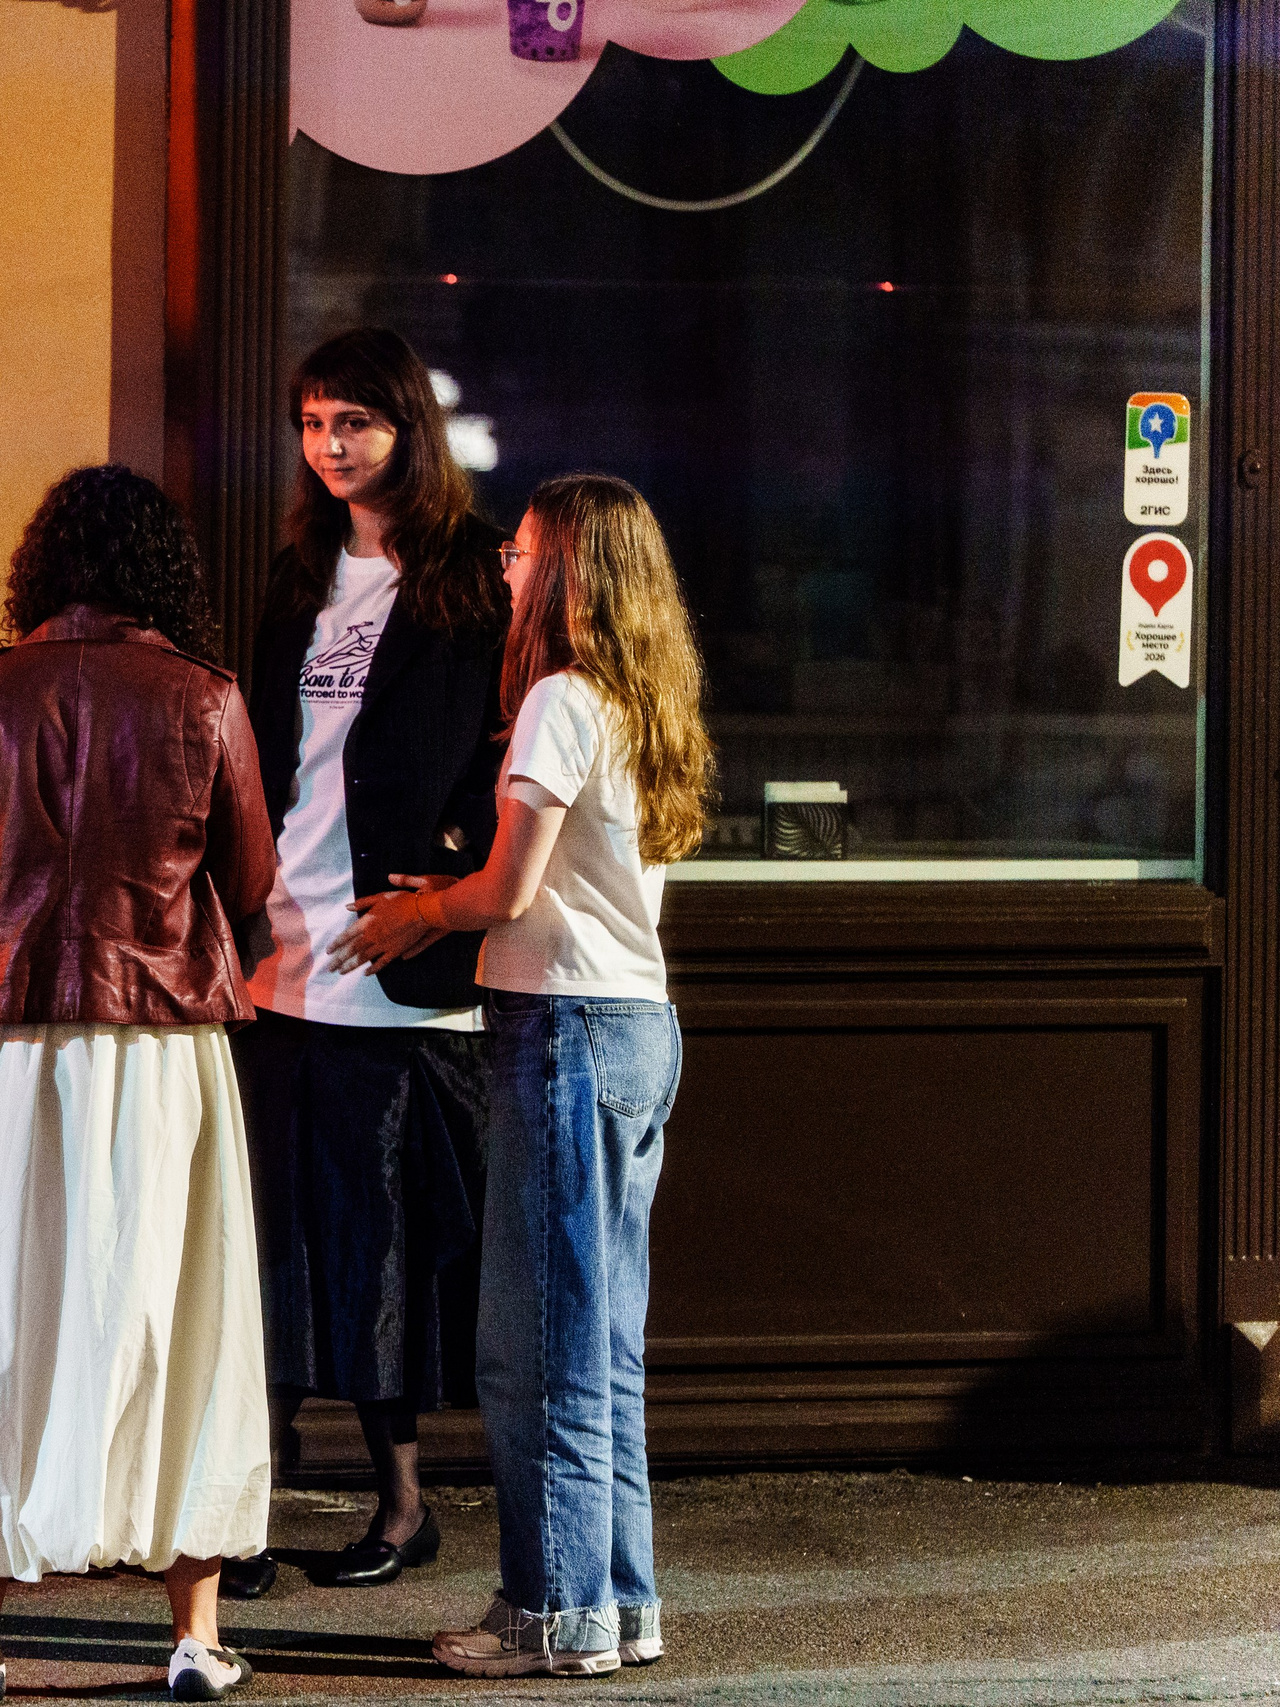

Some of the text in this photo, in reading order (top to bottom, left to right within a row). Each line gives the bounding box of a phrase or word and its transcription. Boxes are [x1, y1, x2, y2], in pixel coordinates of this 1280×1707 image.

[1142, 464, 1173, 475] Здесь
[1135, 475, 1179, 485] хорошо!
[1140, 505, 1171, 516] 2ГИС
[1135, 631, 1177, 642] Хорошее
[1142, 642, 1169, 650] место
[1145, 652, 1166, 662] 2026
[299, 664, 335, 688] Born
[339, 667, 355, 688] to
[300, 688, 363, 699] forced to wo
